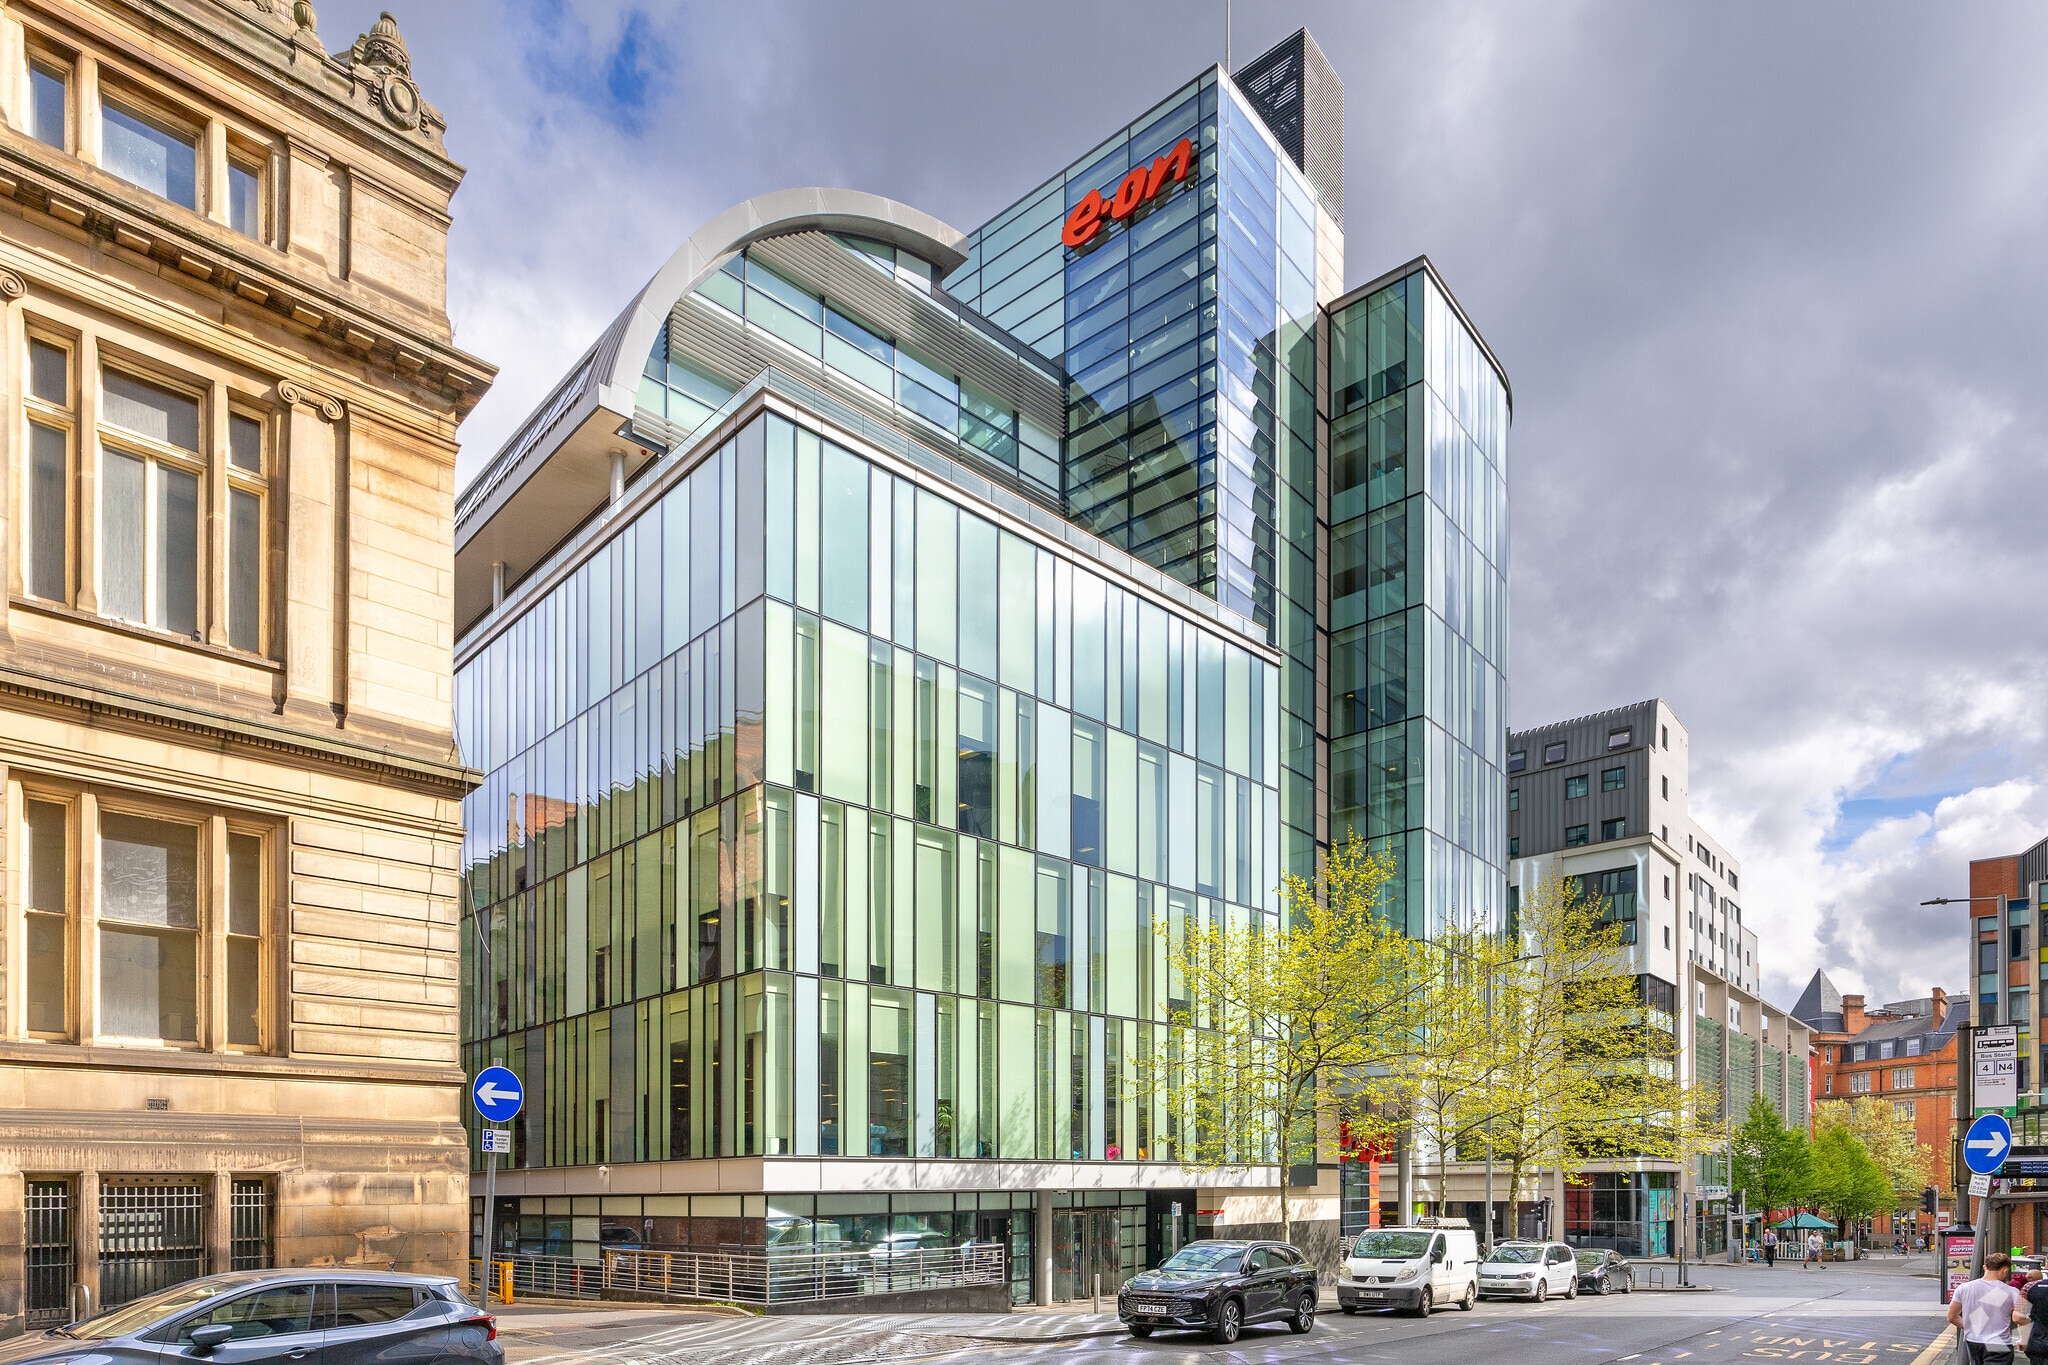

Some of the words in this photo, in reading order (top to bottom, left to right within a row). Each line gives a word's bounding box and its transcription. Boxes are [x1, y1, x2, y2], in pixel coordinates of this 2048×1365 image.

[1982, 1064, 1989, 1072] 4
[1998, 1063, 2013, 1071] N4
[486, 1131, 492, 1139] P
[1750, 1335, 1922, 1353] STAND
[1743, 1348, 1878, 1364] BUS
